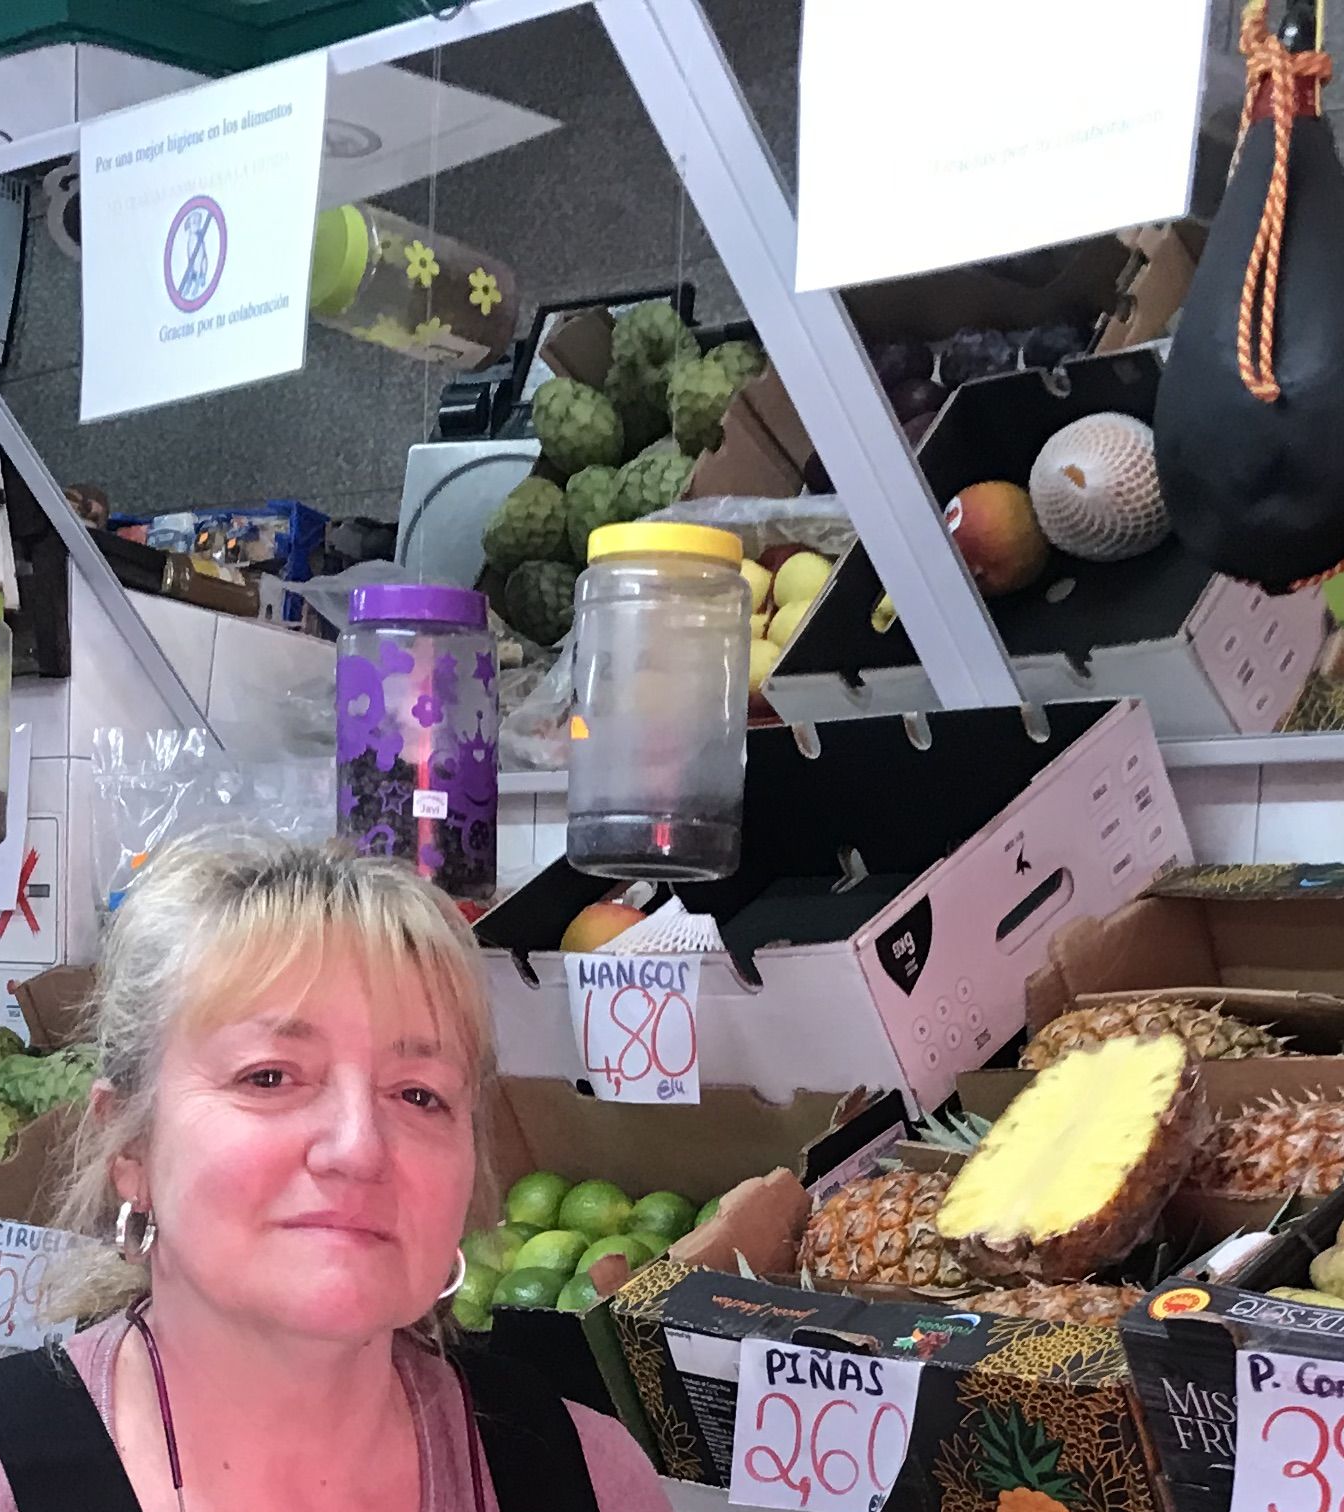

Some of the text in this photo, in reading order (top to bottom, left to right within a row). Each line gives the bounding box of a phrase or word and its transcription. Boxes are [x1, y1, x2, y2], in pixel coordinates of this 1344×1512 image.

[136, 141, 165, 162] mejor
[207, 125, 220, 139] en
[223, 118, 239, 136] los
[241, 103, 292, 130] alimentos
[197, 316, 214, 337] por
[579, 959, 689, 993] MANGOS
[1304, 1310, 1341, 1331] DE
[766, 1347, 884, 1396] PIÑAS
[1248, 1360, 1281, 1394] P.
[1162, 1378, 1237, 1423] MIS
[744, 1392, 909, 1507] 2,60
